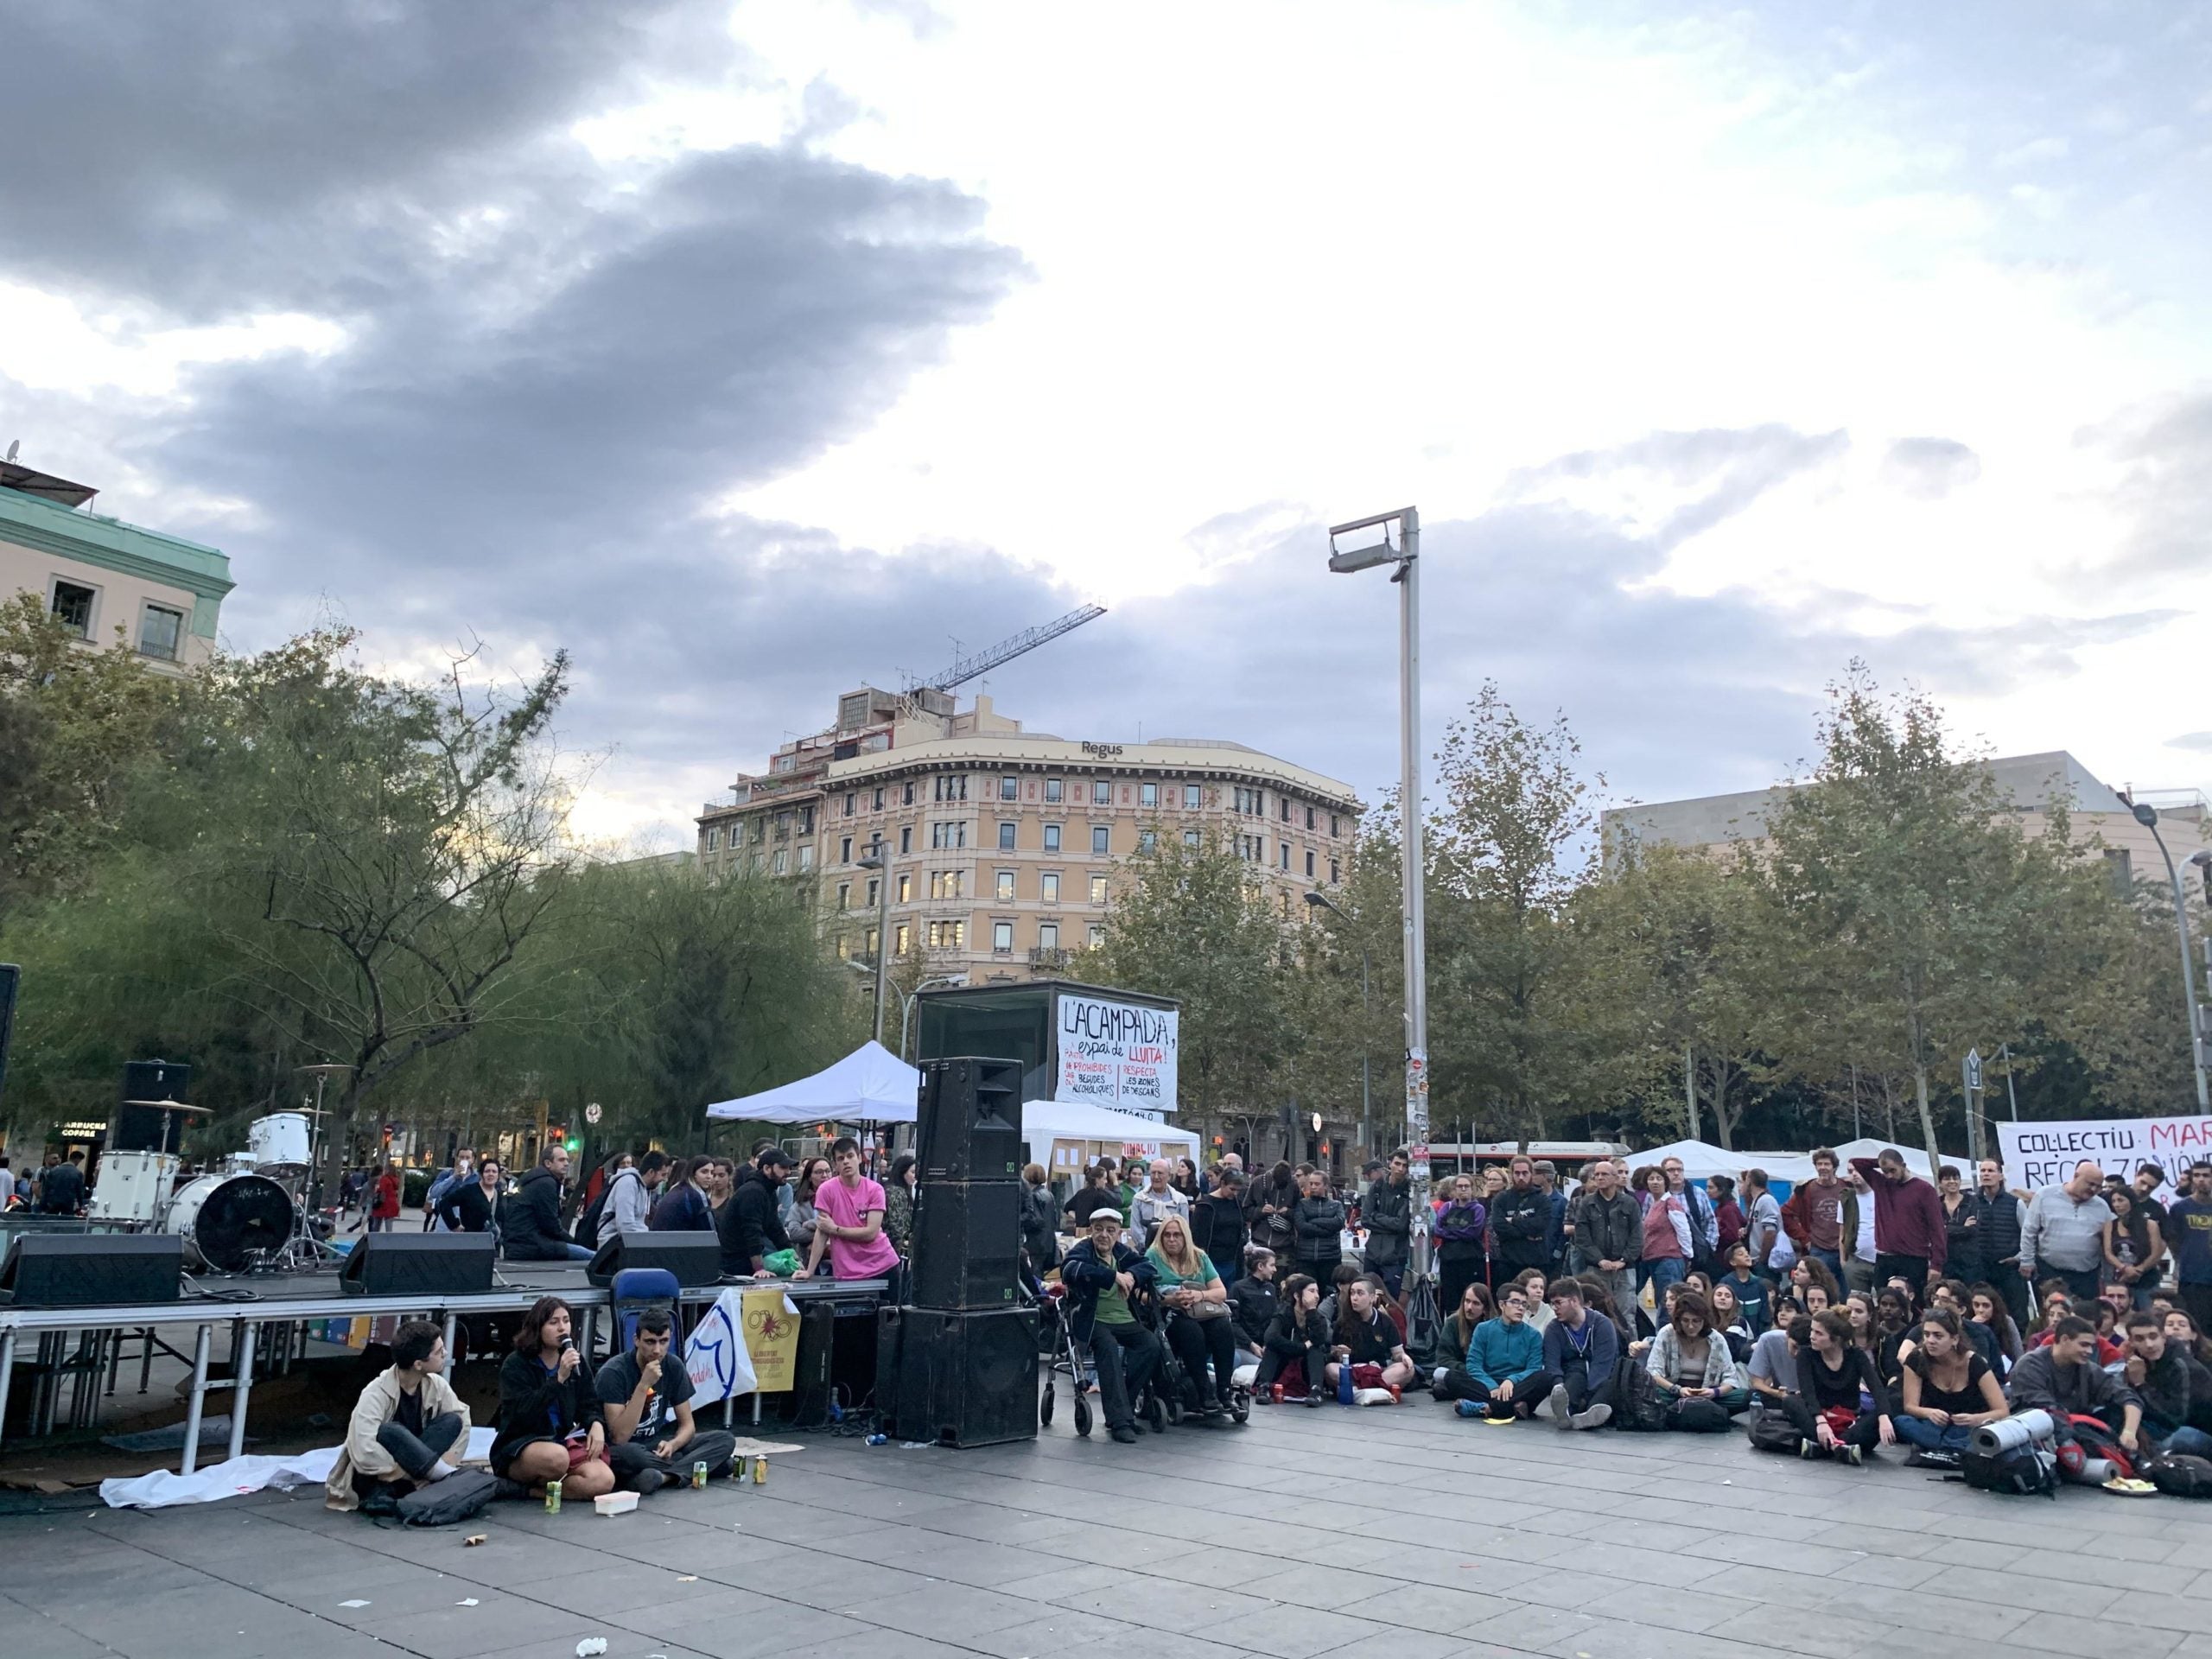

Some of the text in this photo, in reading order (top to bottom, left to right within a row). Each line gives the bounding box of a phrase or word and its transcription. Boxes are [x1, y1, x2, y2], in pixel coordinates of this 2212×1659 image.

[1082, 741, 1123, 759] Regus
[1064, 1000, 1176, 1050] L'ACAMPADA,
[1077, 1040, 1166, 1065] espai de LLUITA!
[1073, 1062, 1113, 1074] PROHIBIDES
[1122, 1065, 1157, 1077] RESPECTA
[1126, 1077, 1160, 1088] LES ZONES
[1122, 1084, 1130, 1095] DE
[54, 1121, 107, 1130] SARBUCKS
[61, 1129, 96, 1138] COFFEE
